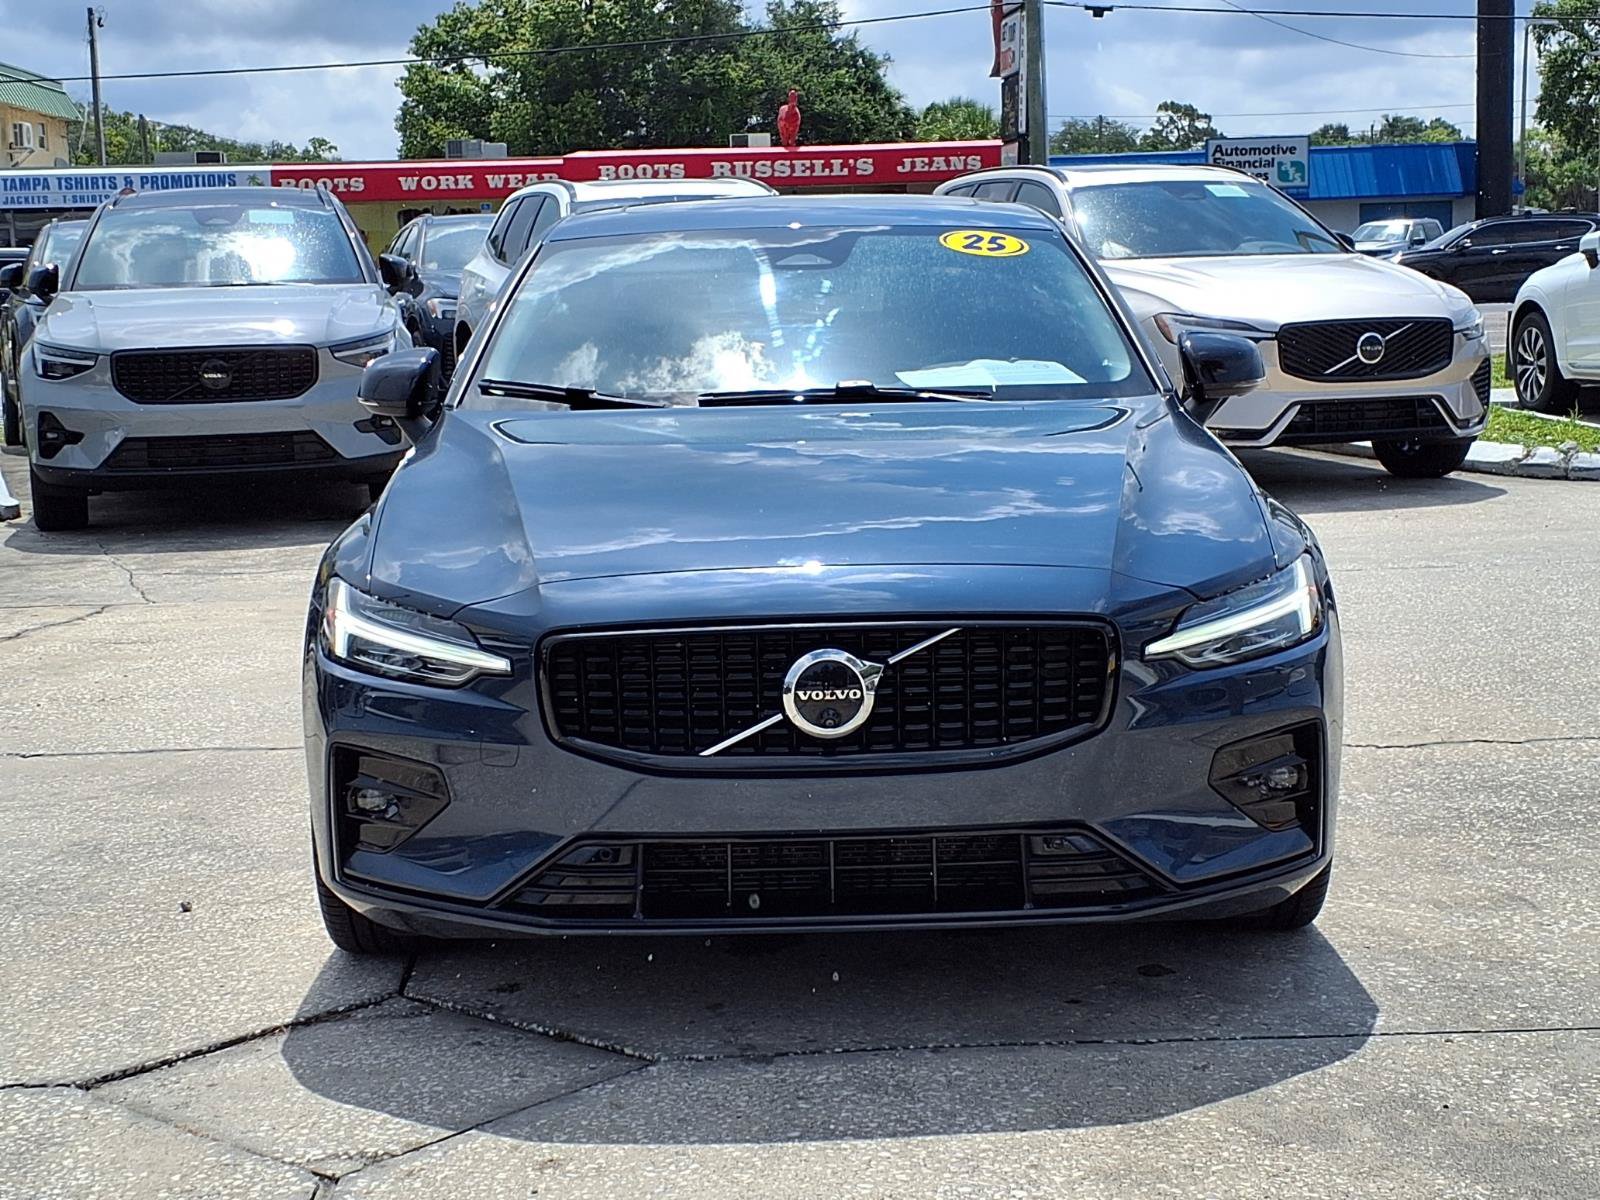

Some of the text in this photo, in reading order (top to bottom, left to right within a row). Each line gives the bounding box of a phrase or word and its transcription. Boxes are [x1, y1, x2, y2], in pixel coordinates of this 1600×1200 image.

[1211, 144, 1297, 157] Automotive
[598, 155, 982, 180] BOOTS RUSSELL'S JEANS
[1212, 157, 1275, 169] Financial
[1, 173, 237, 192] TAMPA TSHIRTS & PROMOTIONS
[279, 177, 365, 192] BOOTS
[398, 174, 475, 191] WORK
[2, 195, 49, 205] JACKETS
[961, 234, 1007, 252] 25
[796, 689, 862, 701] VOLVO
